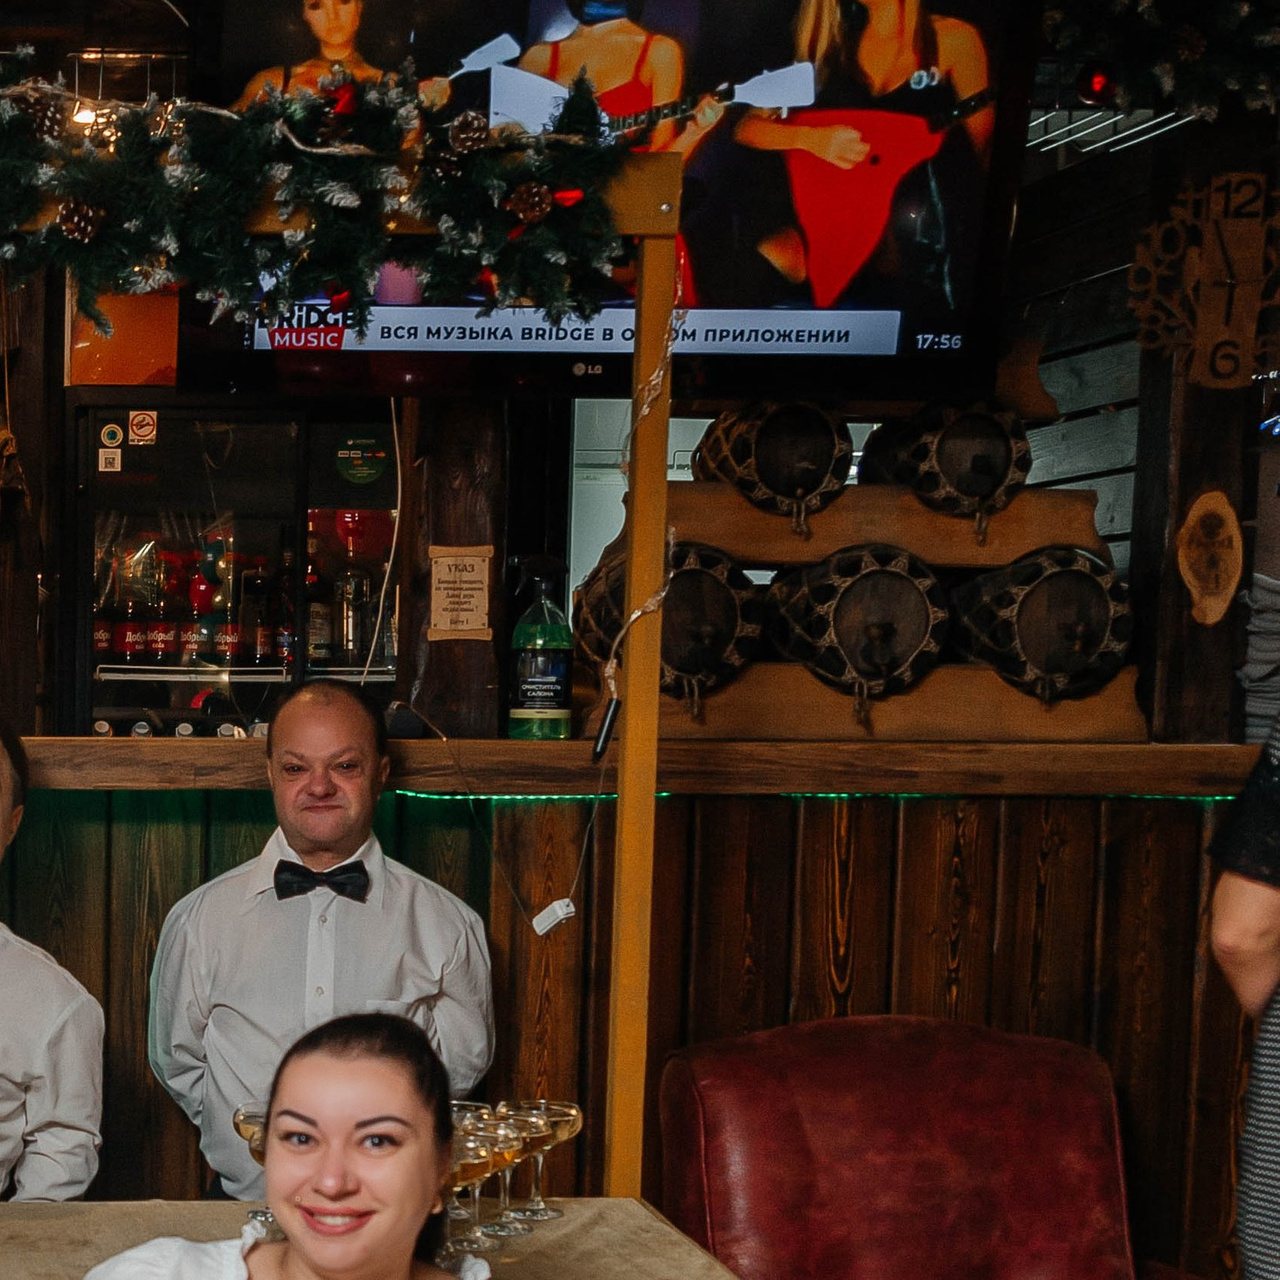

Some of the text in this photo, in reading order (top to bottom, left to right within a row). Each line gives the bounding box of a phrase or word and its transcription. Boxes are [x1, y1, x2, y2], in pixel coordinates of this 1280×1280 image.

[1215, 178, 1261, 218] 12
[273, 331, 339, 347] MUSIC
[380, 325, 851, 343] ВСЯ МУЗЫКА BRIDGE В ООМ ПРИЛОЖЕНИИ
[915, 333, 963, 349] 17:56
[1210, 339, 1240, 380] 6
[587, 365, 603, 375] LG
[447, 563, 475, 573] УКАЗ
